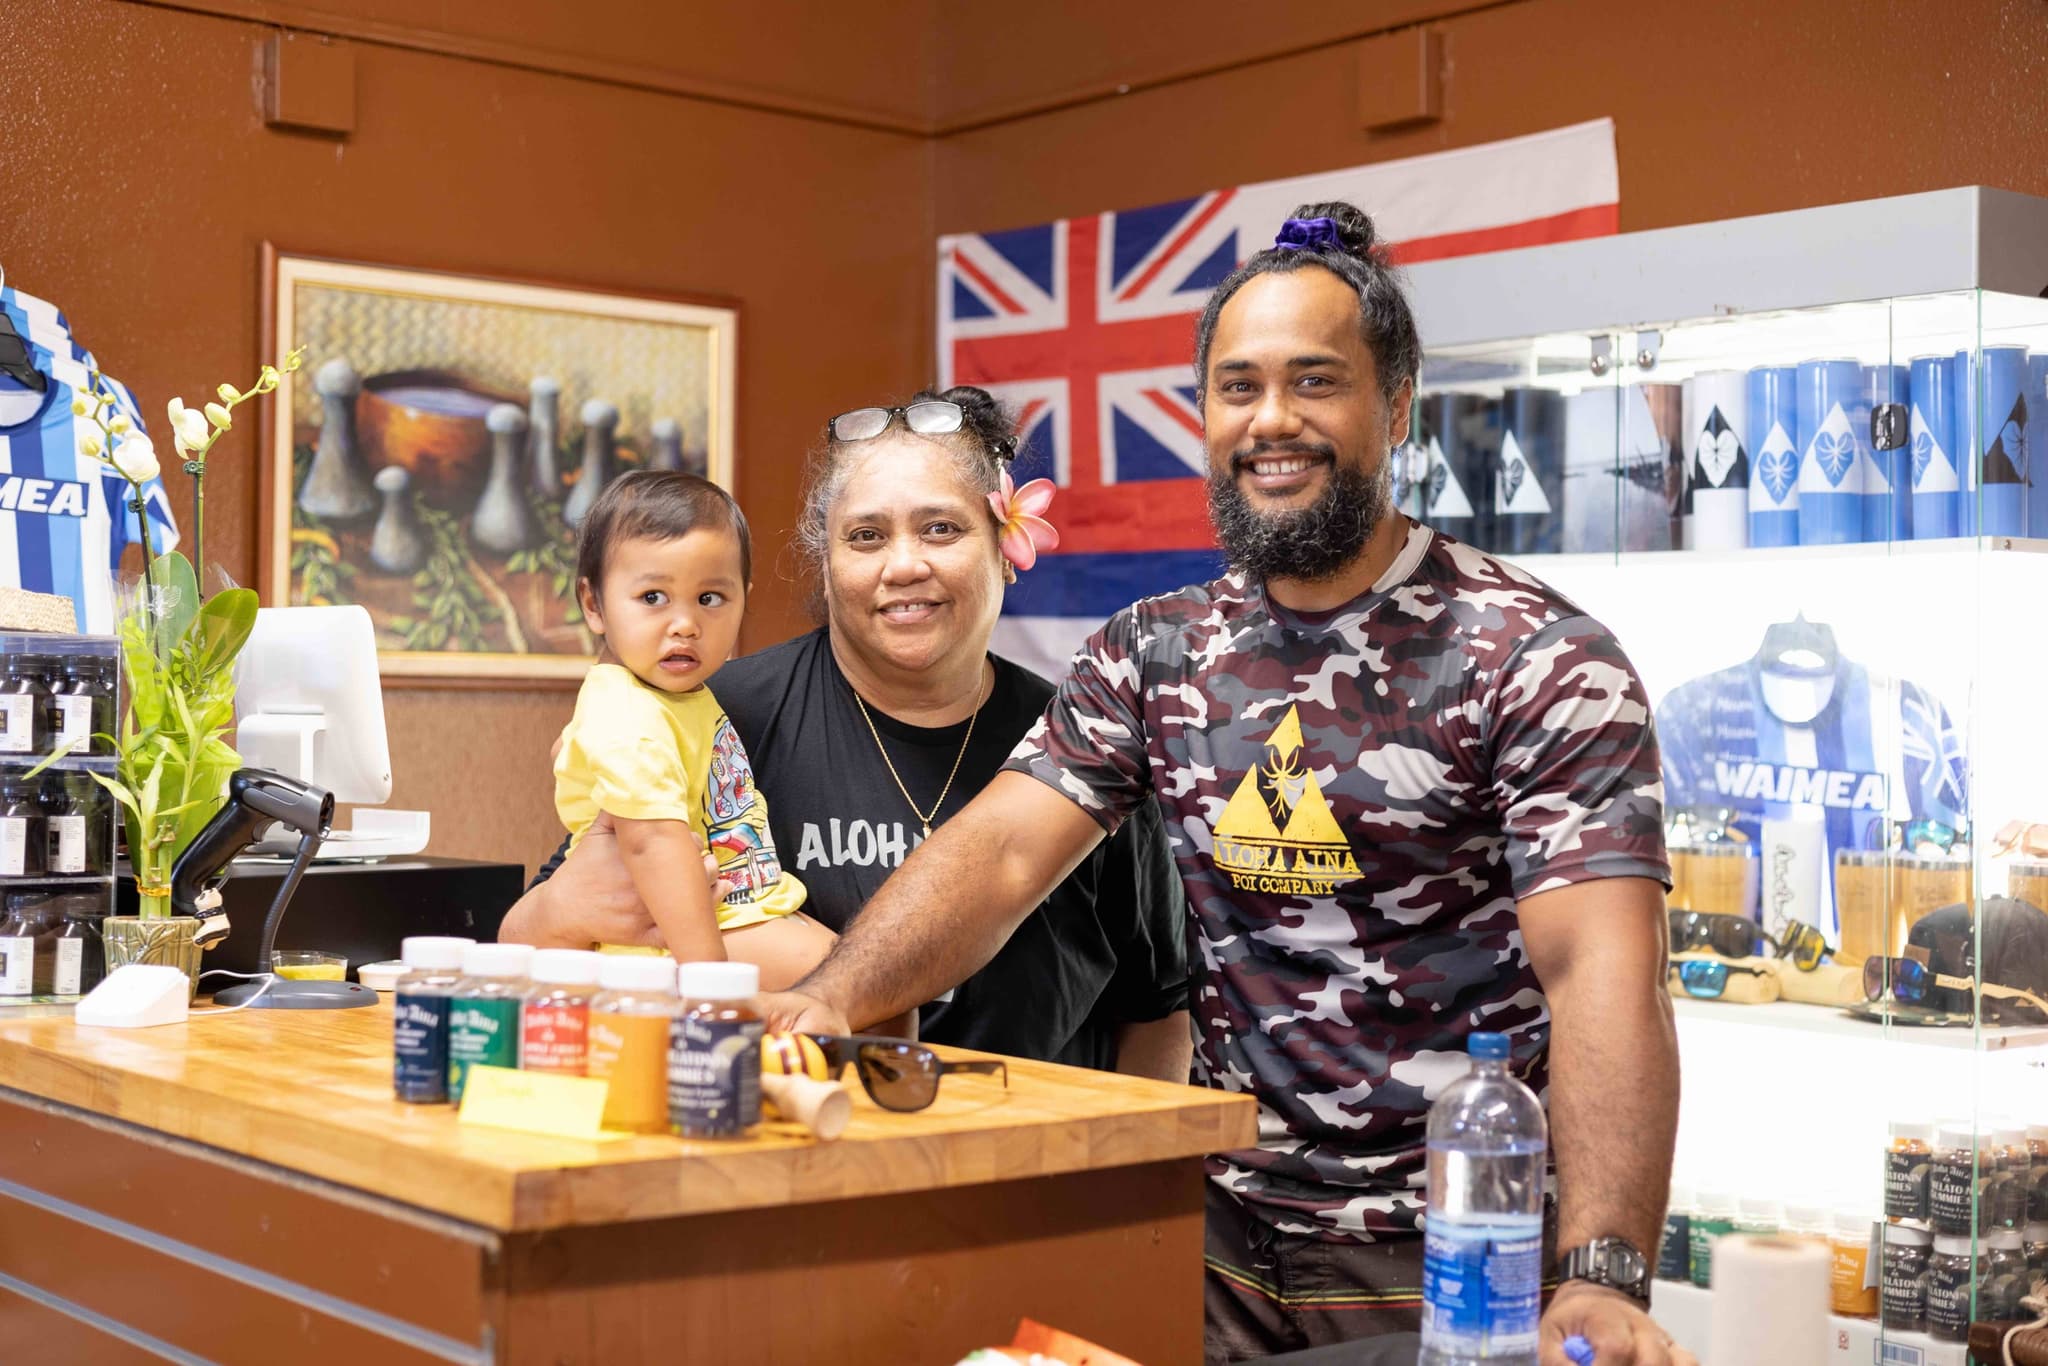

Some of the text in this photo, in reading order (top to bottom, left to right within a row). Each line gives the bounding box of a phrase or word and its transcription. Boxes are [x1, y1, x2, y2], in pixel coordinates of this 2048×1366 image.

[1714, 760, 1885, 811] WAIMEA
[1213, 841, 1361, 873] ALOHA AINA
[1231, 873, 1334, 894] POI COMPANY
